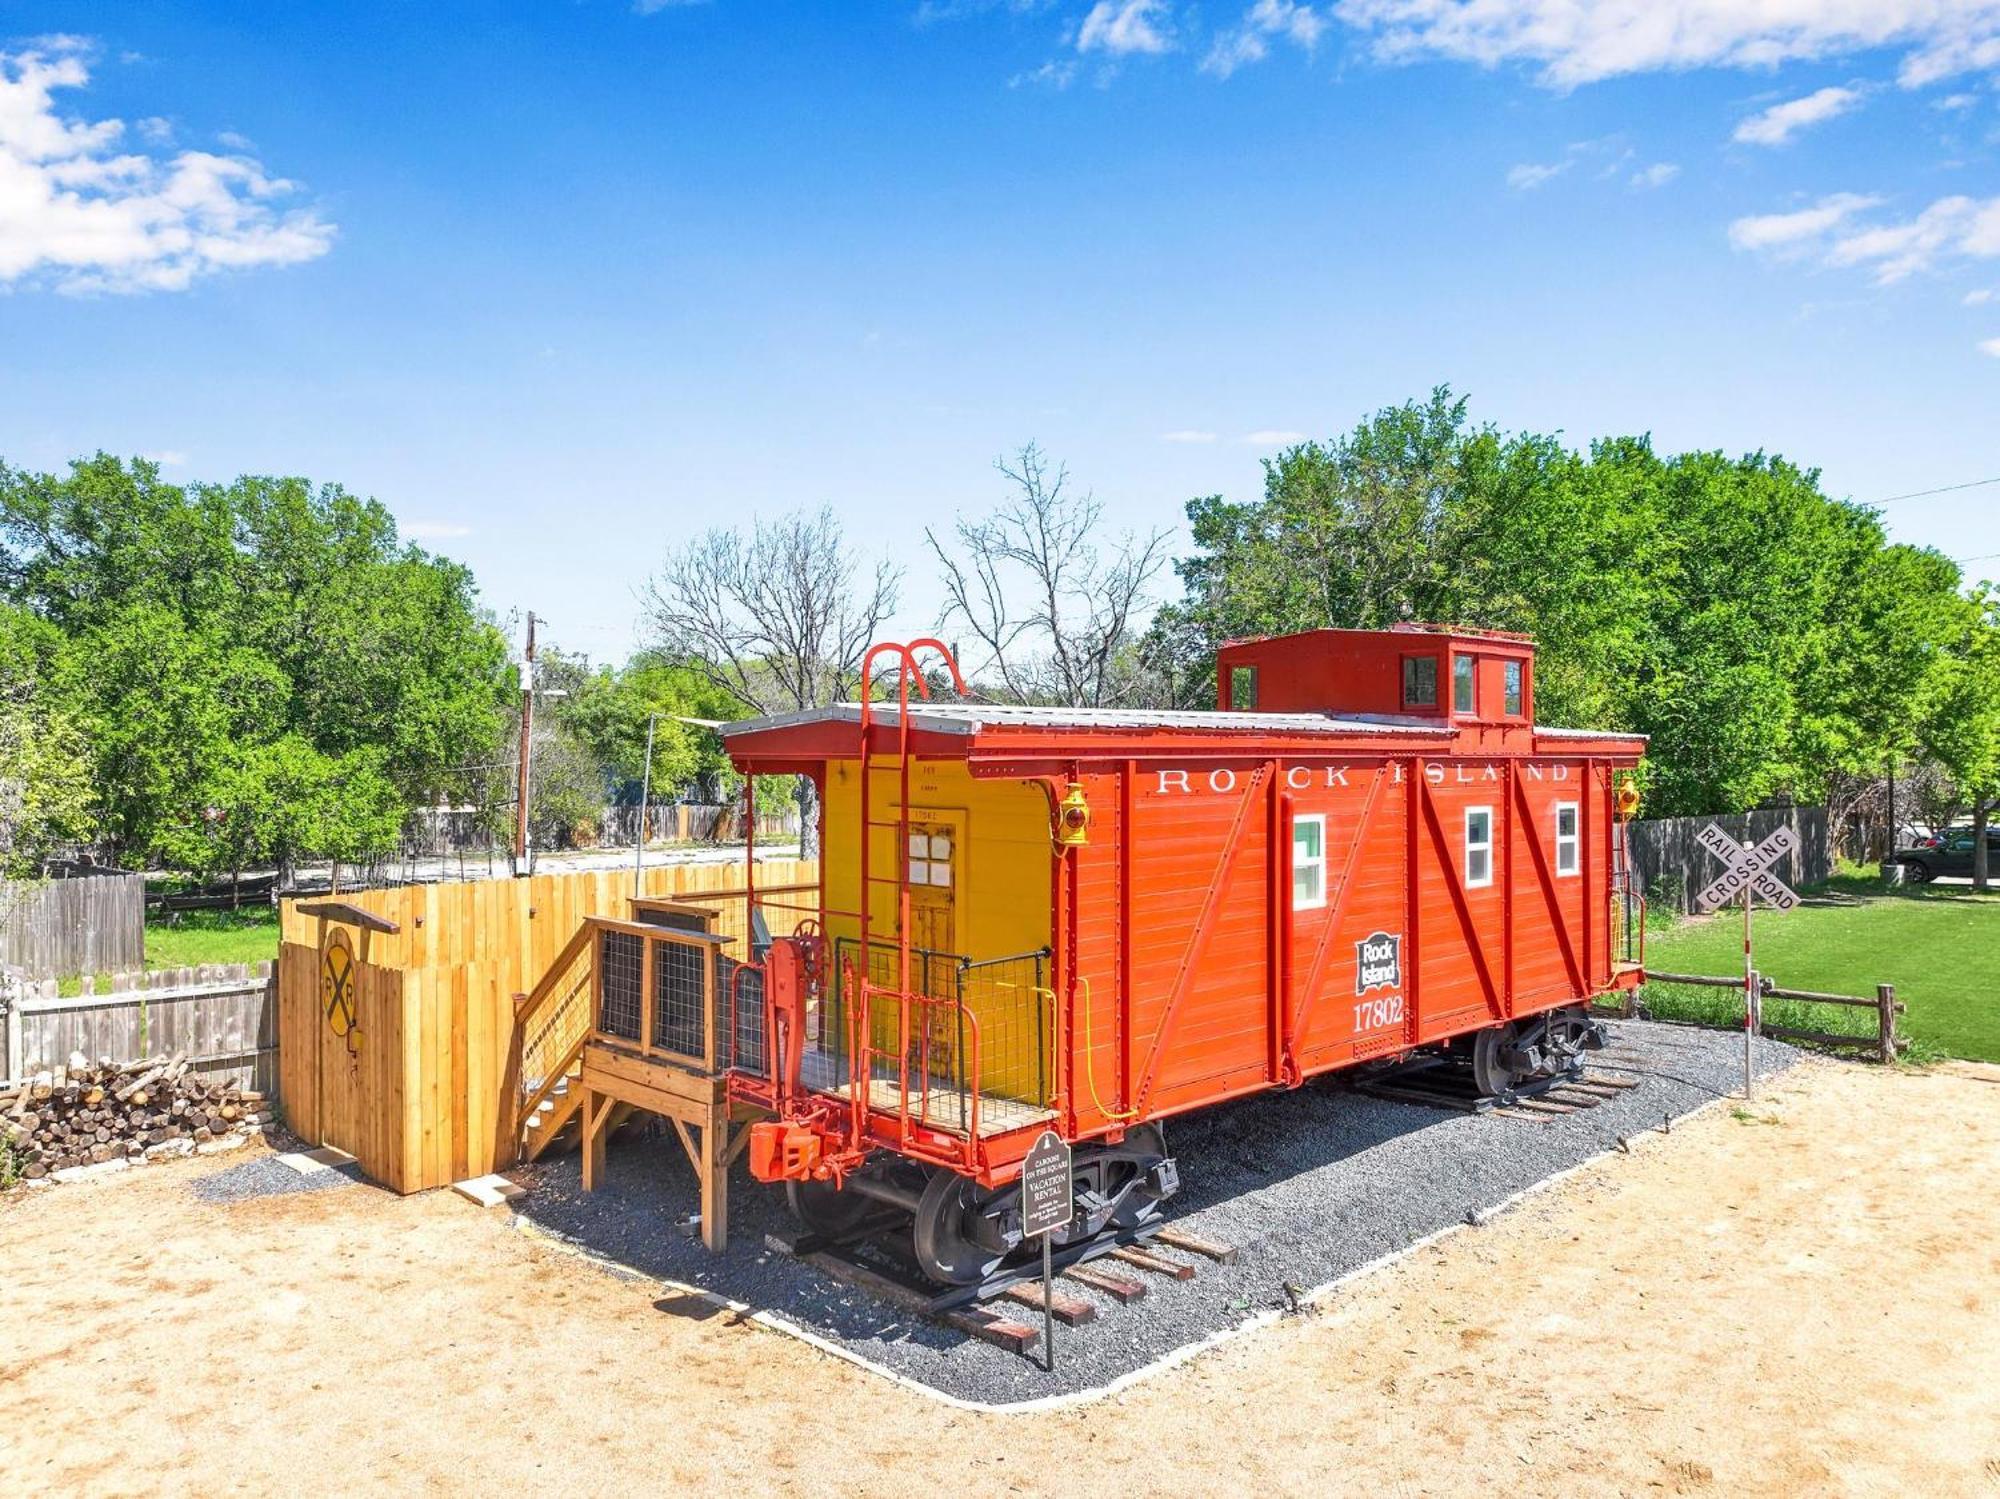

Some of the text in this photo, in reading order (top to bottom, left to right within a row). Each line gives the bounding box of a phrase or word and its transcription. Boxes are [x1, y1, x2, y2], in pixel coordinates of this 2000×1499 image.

[1155, 763, 1568, 793] ROCK ISLAND
[1701, 829, 1793, 909] RAIL ROAD
[1706, 834, 1789, 904] CROSSING
[1363, 940, 1393, 963] Rock
[1362, 960, 1395, 985] Island
[346, 983, 353, 1006] R
[1354, 995, 1404, 1033] 17802
[1029, 1173, 1066, 1192] VACATION
[1034, 1185, 1062, 1202] RENTAL
